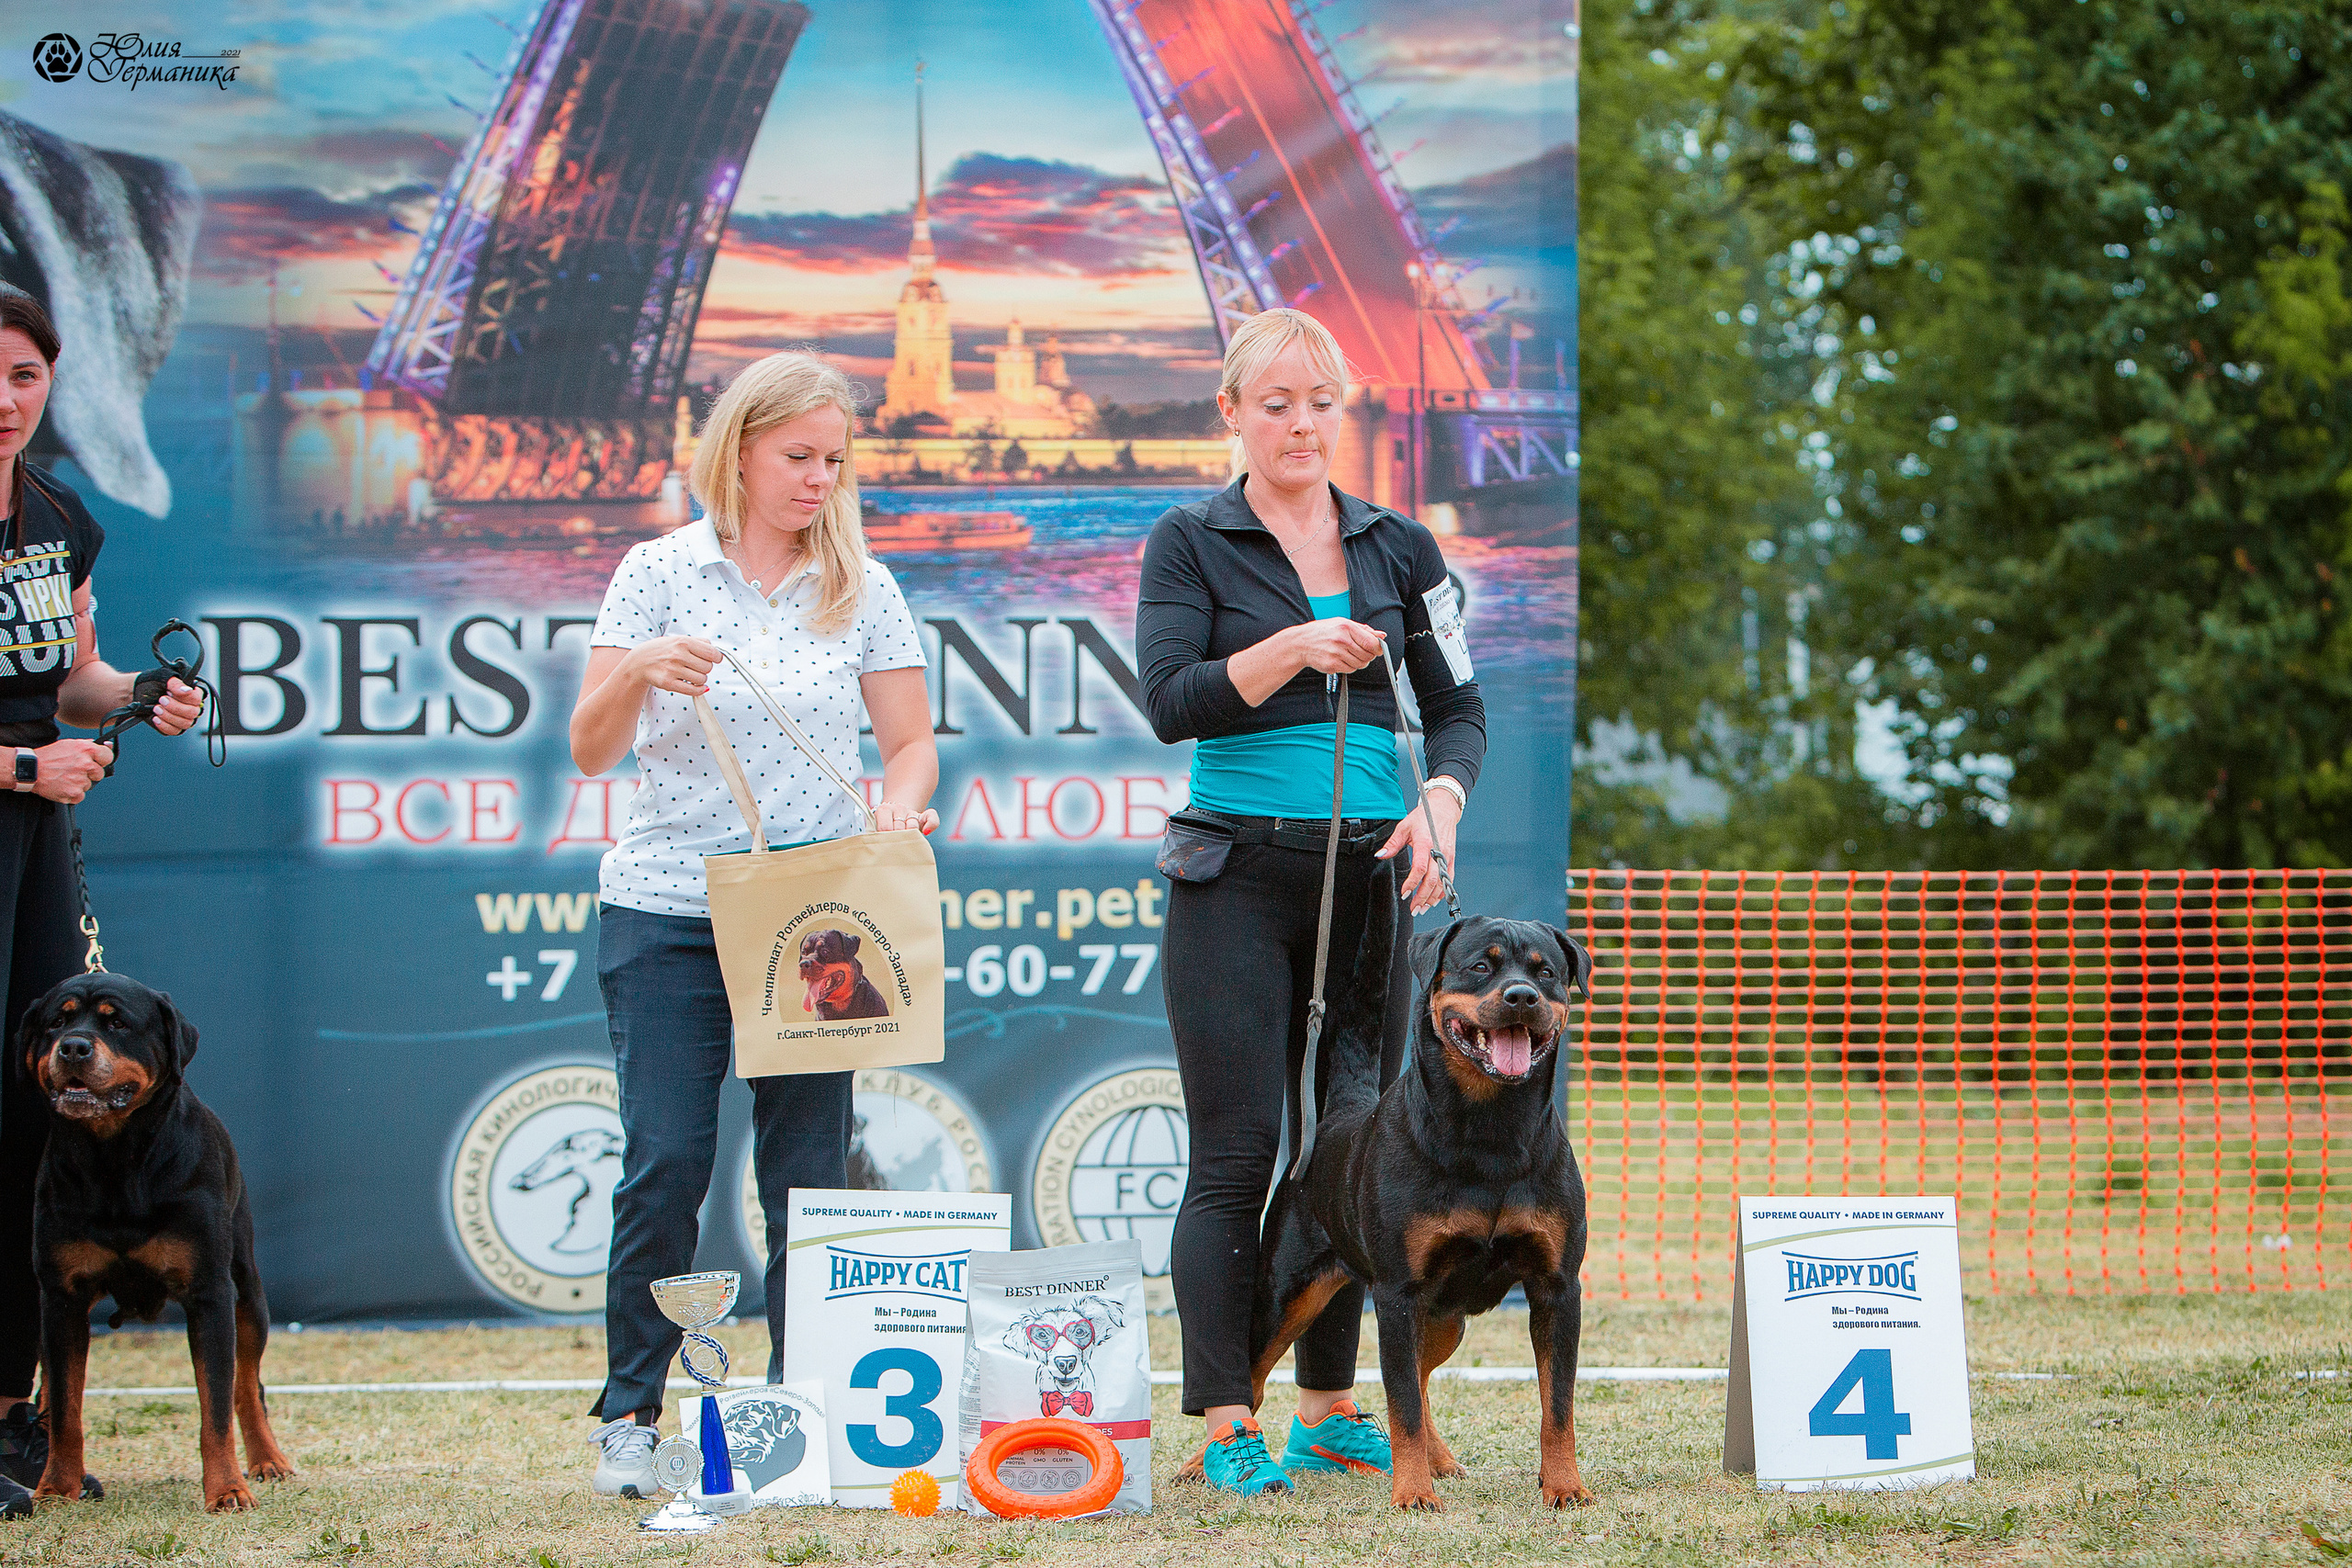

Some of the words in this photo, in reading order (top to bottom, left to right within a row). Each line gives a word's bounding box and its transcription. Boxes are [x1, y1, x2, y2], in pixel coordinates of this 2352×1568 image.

[322, 777, 523, 847] ВСЕ
[761, 942, 783, 1017] Чемпионат
[775, 900, 850, 942] Ротвейлеров
[851, 908, 912, 1007] «Северо-Запада»
[485, 949, 579, 1002] +7
[776, 1026, 872, 1041] г.Санкт-Петербург
[874, 1022, 900, 1033] 2021
[802, 1207, 847, 1217] SUPREME
[850, 1209, 892, 1218] QUALITY
[903, 1210, 932, 1219] MADE
[934, 1211, 945, 1219] IN
[947, 1211, 998, 1220] GERMANY
[1752, 1211, 1797, 1219] SUPREME
[1799, 1212, 1840, 1220] QUALITY
[1852, 1212, 1880, 1220] MADE
[1883, 1212, 1893, 1220] IN
[1895, 1212, 1944, 1220] GERMANY
[829, 1254, 912, 1292] HAPPY
[915, 1258, 967, 1292] CAT
[1786, 1259, 1864, 1292] HAPPY
[1869, 1260, 1917, 1292] DOG
[1004, 1285, 1043, 1297] BEST
[1046, 1280, 1106, 1296] DINNER
[875, 1307, 891, 1317] Мы
[900, 1307, 937, 1318] Родина
[1831, 1306, 1848, 1315] Мы
[1856, 1306, 1888, 1316] Родина
[874, 1324, 925, 1334] здорового
[1833, 1320, 1880, 1329] здорового
[1882, 1321, 1920, 1329] питания.
[846, 1348, 944, 1468] 3
[1808, 1348, 1911, 1460] 4
